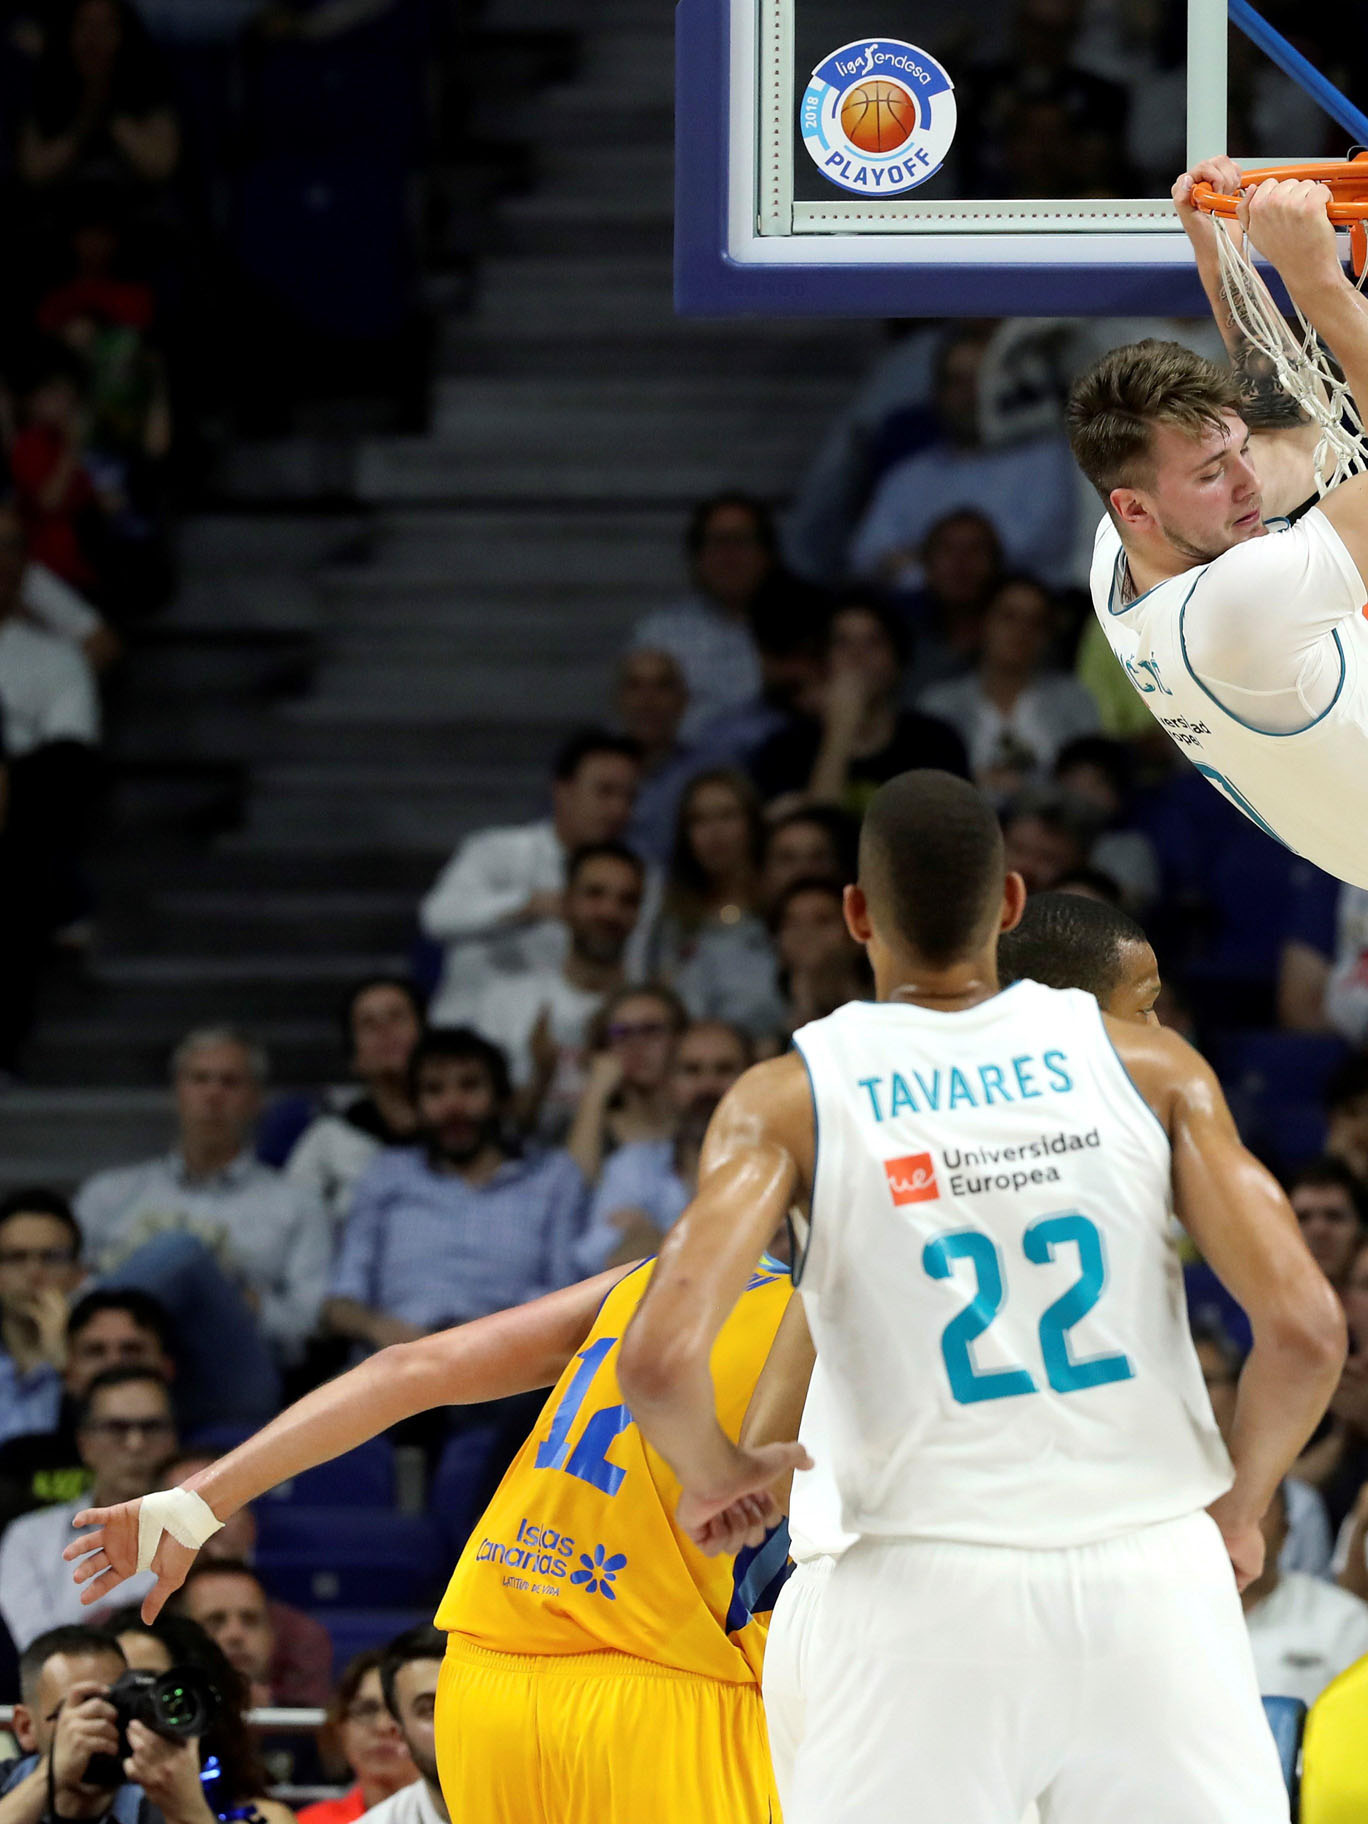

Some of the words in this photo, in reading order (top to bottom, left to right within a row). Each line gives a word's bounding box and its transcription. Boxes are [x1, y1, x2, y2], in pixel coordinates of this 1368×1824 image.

[805, 96, 819, 128] 2018
[825, 148, 930, 186] PLAYOFF
[857, 1050, 1073, 1123] TAVARES
[943, 1128, 1101, 1169] Universidad
[950, 1165, 1061, 1196] Europea
[921, 1208, 1136, 1406] 22
[476, 1537, 568, 1578] Canarias
[516, 1518, 575, 1557] Islas
